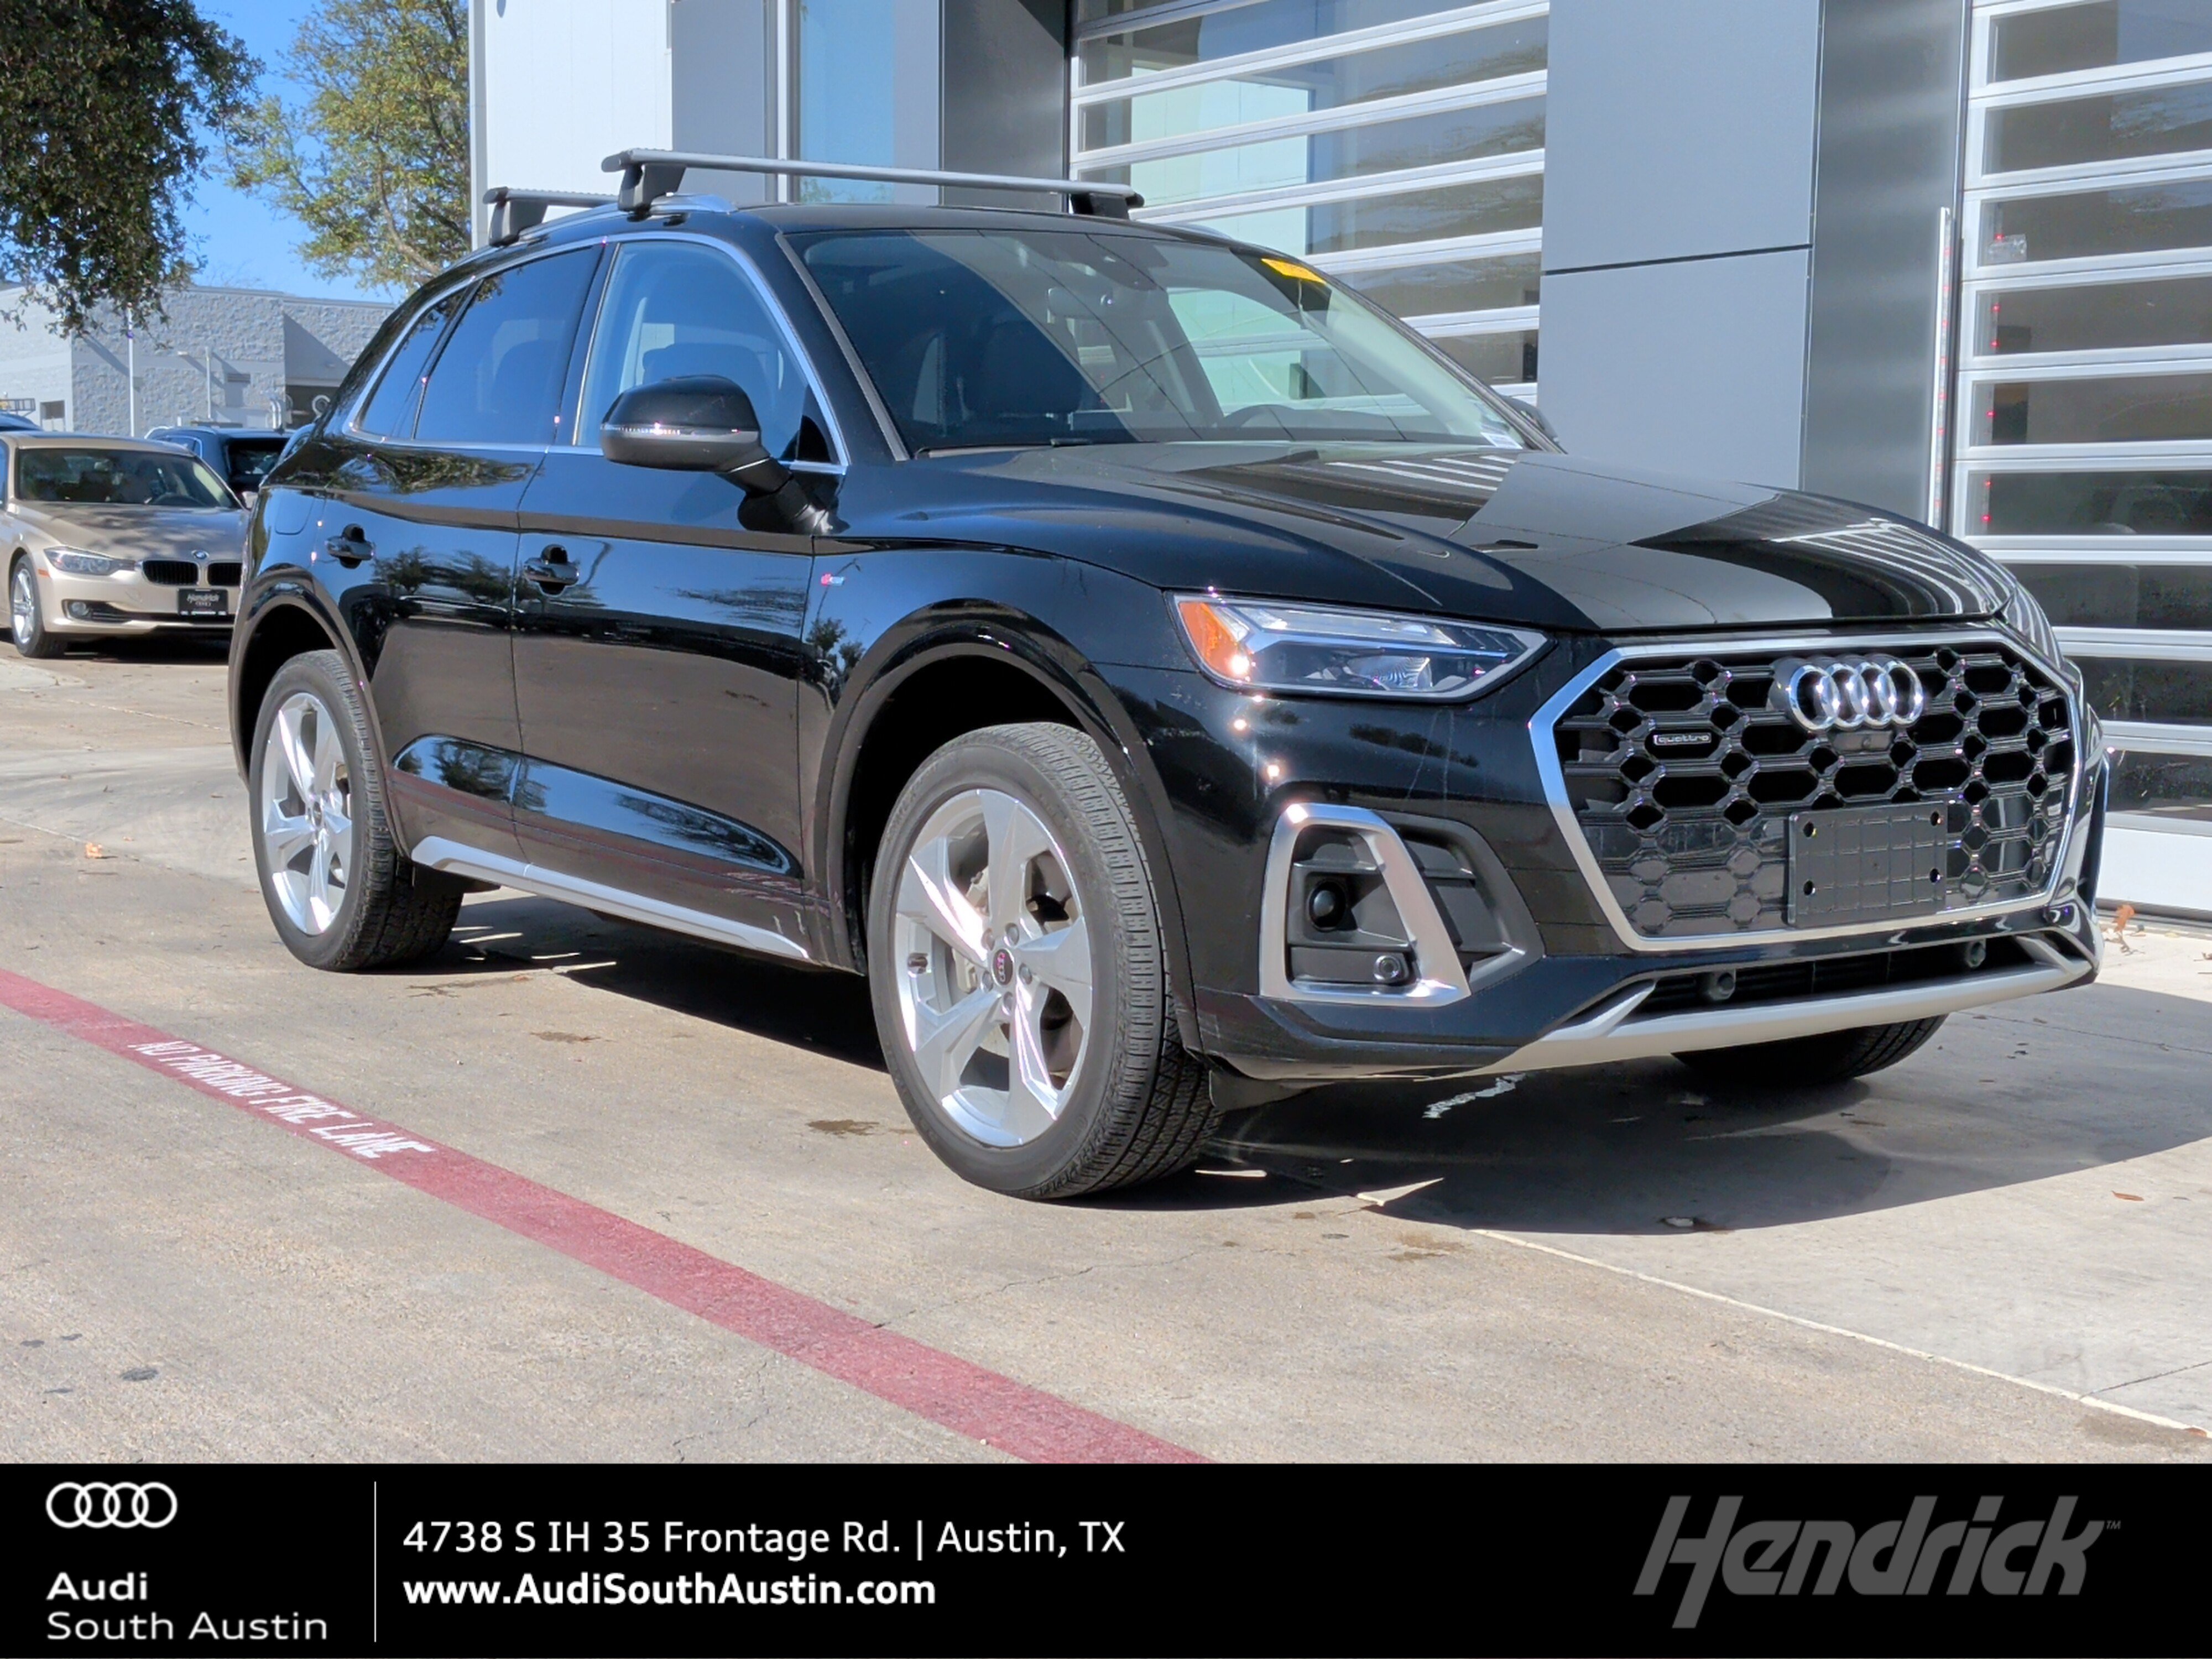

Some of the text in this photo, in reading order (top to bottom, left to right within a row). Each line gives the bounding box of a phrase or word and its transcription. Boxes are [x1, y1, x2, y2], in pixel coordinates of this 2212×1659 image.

[1659, 735, 1709, 743] quattro
[127, 1040, 437, 1158] NO PARKING FIRE LANE
